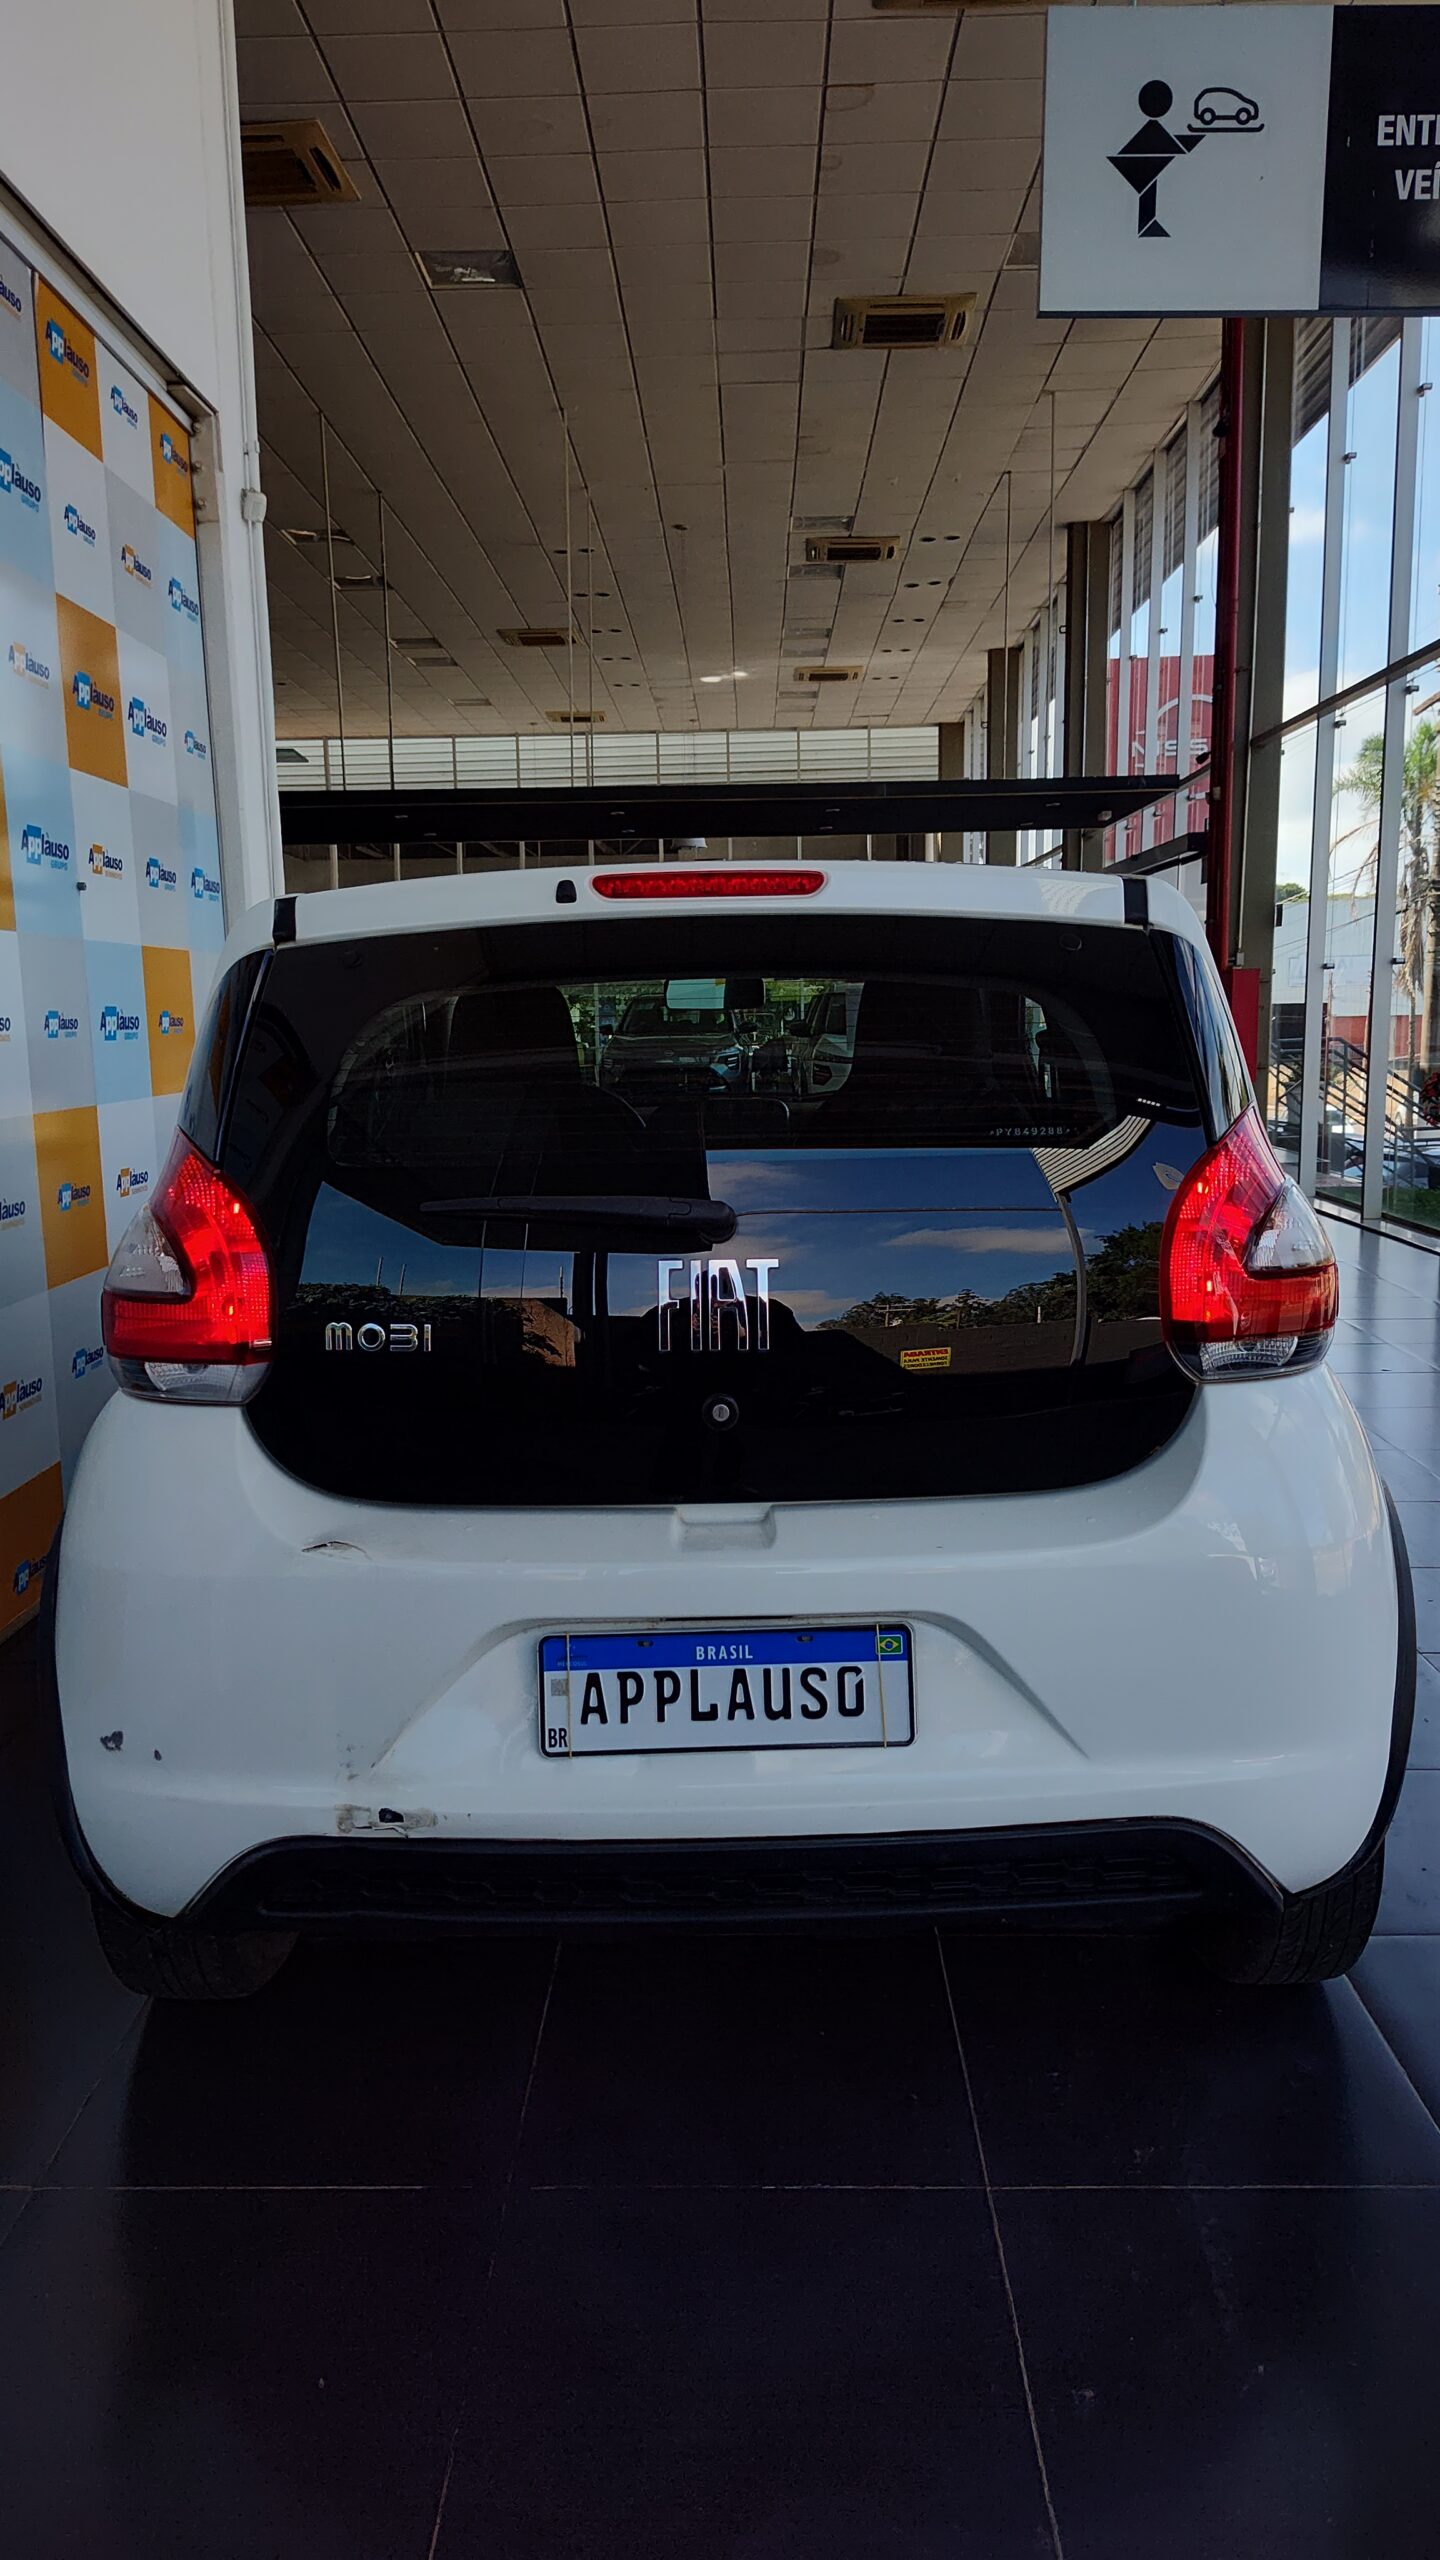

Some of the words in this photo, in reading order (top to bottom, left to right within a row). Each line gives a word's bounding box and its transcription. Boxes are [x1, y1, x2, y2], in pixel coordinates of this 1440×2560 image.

[657, 1258, 780, 1351] FIAT
[325, 1322, 432, 1352] MOBI
[696, 1645, 754, 1661] BRASIL
[580, 1665, 865, 1725] APPLAUSO
[548, 1728, 568, 1749] BR
